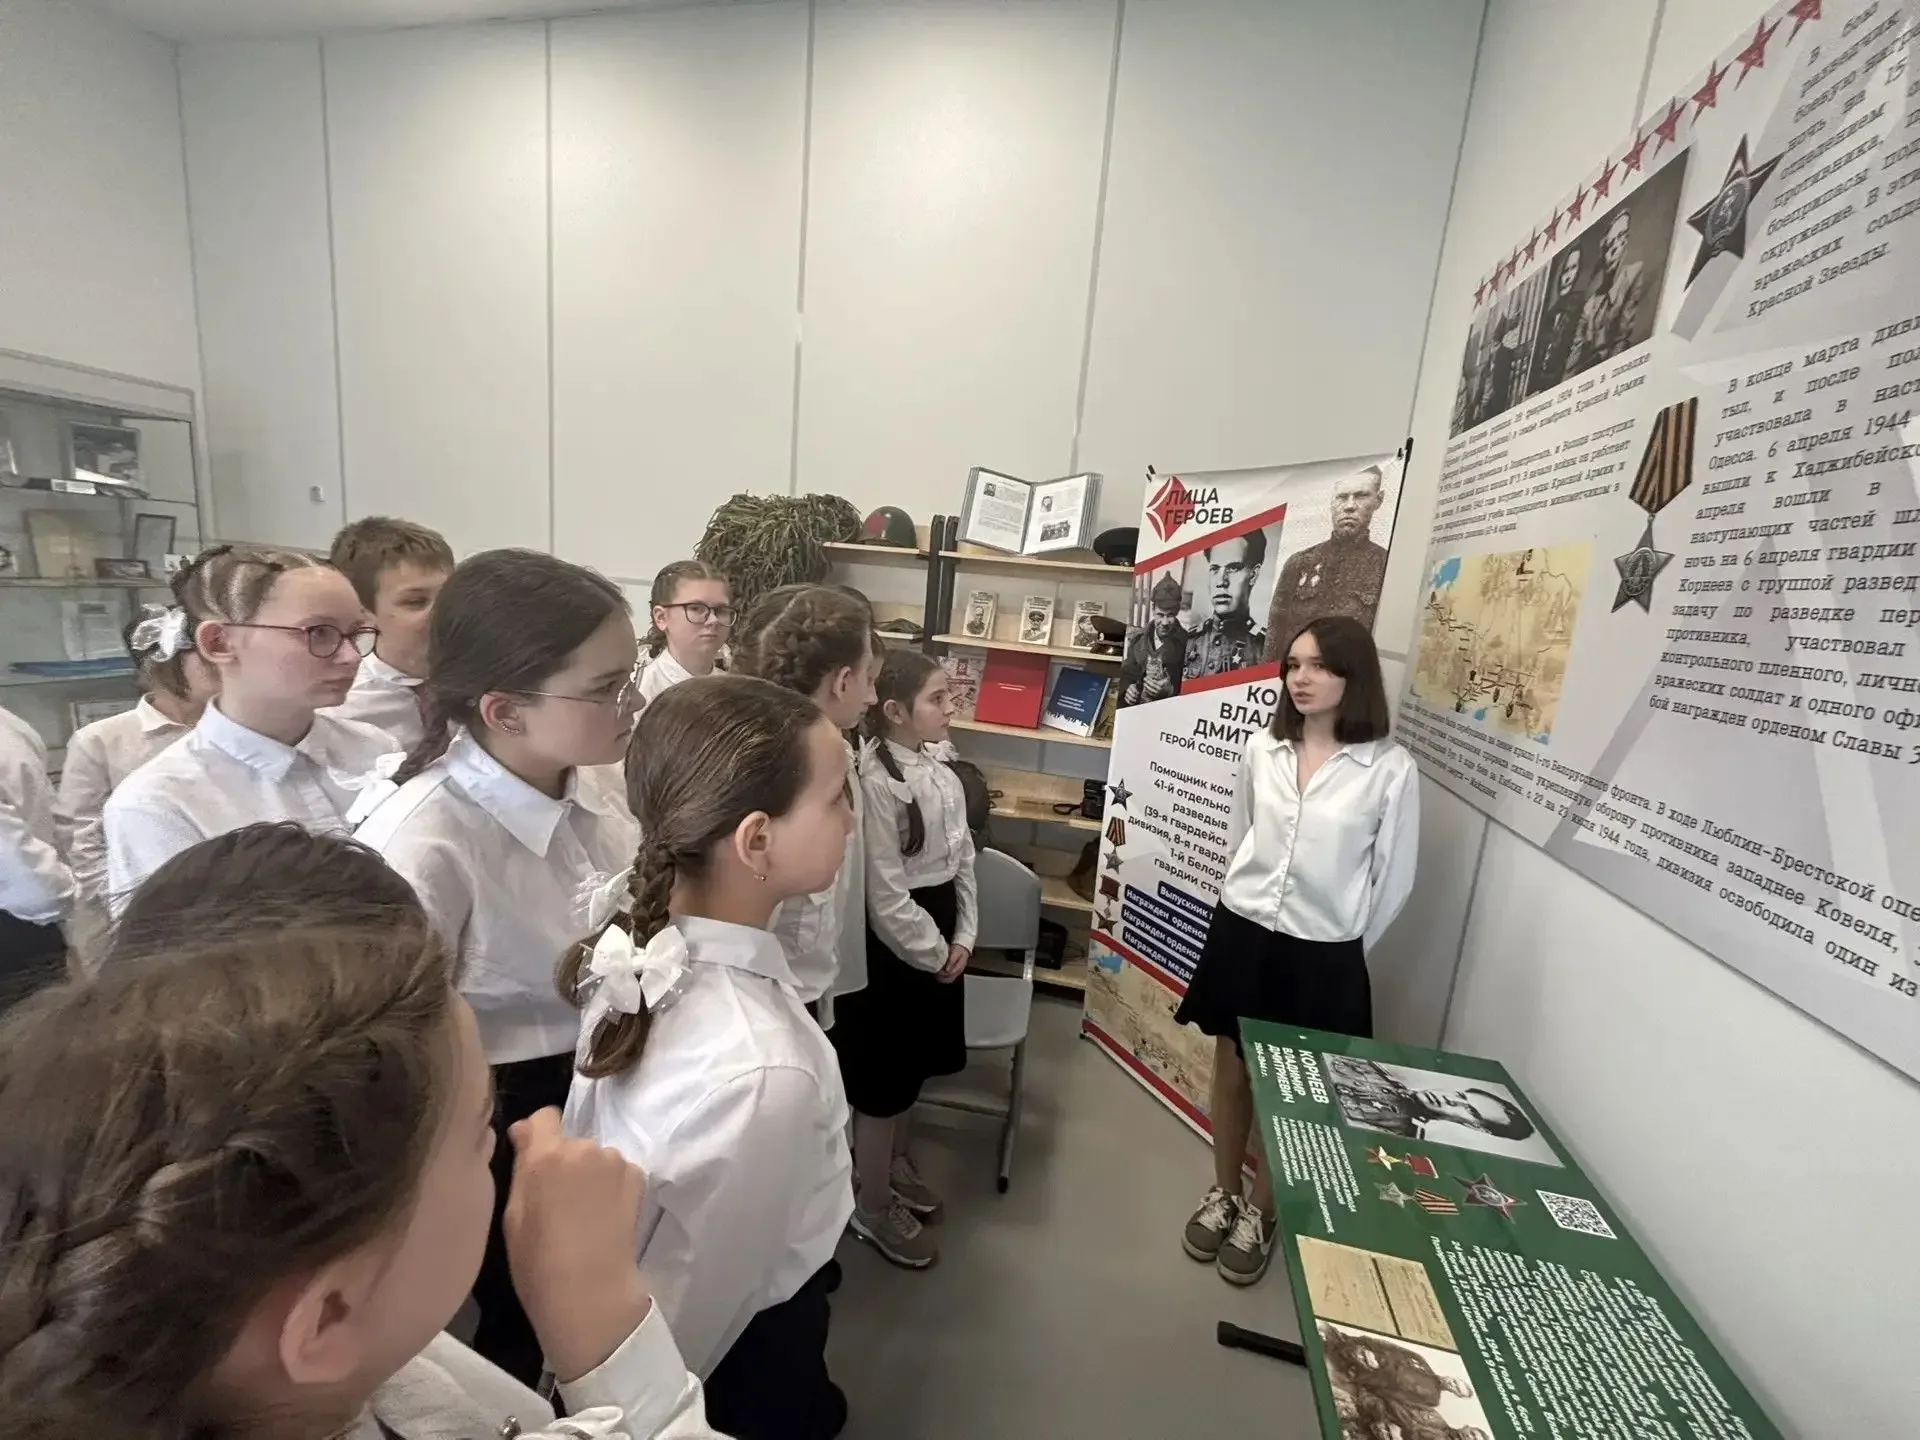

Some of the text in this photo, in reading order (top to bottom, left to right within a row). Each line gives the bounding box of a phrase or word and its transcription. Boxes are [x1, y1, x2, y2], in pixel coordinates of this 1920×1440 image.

[1747, 275, 1815, 318] Красной
[1728, 378, 1737, 393] В
[1746, 361, 1793, 387] конце
[1803, 337, 1859, 367] марта
[1773, 390, 1785, 402] и
[1805, 366, 1860, 393] после
[1714, 399, 1847, 447] участвовала в
[1768, 441, 1778, 457] 6
[1787, 426, 1853, 452] апреля
[1864, 410, 1911, 436] 1944
[1702, 443, 1920, 495] вышли к Хаджибейско
[1165, 487, 1218, 506] ЛИЦА
[1695, 482, 1881, 520] апреля вошли в
[1163, 508, 1234, 525] ГЕРОЕВ
[1690, 522, 1794, 544] наступающих
[1809, 510, 1876, 532] частей
[1684, 542, 1917, 568] ночь на 6 апреля гвардии
[1678, 574, 1918, 594] Корнеев с группой развед
[1672, 605, 1855, 622] задачу по разведке
[1666, 628, 1906, 657] противника, участвовал
[1660, 651, 1920, 693] контрольного пленного, личн
[1654, 673, 1725, 695] вражеских
[1730, 685, 1785, 705] солдат
[1789, 694, 1803, 708] и
[1808, 698, 1875, 720] одного
[1649, 695, 1670, 709] бой
[1672, 702, 1747, 727] награжден
[1752, 718, 1826, 743] орденом
[1833, 730, 1903, 760] Славы
[1160, 732, 1242, 762] ГЕРОЙ СОВЕТ
[1150, 762, 1208, 789] Помощник
[1144, 805, 1167, 823] (39-я
[1154, 779, 1174, 794] 41-й
[1177, 789, 1231, 814] отдельно
[1128, 816, 1171, 842] дивизия,
[1174, 834, 1190, 848] 8-я
[1173, 803, 1228, 830] разведыв
[1170, 848, 1185, 863] 1-й
[1656, 802, 1666, 815] В
[1668, 808, 1698, 828] ходе
[1701, 820, 1876, 902] Люблин-Брестской
[1155, 858, 1198, 885] гвардии
[1595, 801, 1637, 829] оборону
[1641, 823, 1719, 866] противника
[1726, 861, 1806, 905] западнее
[1816, 898, 1899, 953] Ковеля,
[1126, 889, 1169, 919] Награжден
[1160, 886, 1208, 919] Выпускник
[1599, 824, 1620, 845] 1944
[1656, 856, 1714, 891] дивизия
[1719, 887, 1815, 945] освободила
[1825, 941, 1880, 977] один
[1889, 972, 1918, 998] из
[1123, 909, 1166, 940] Награжден
[1125, 932, 1193, 980] Награжден меда
[1267, 1043, 1295, 1104] ДМИТРИЕВИЧ
[1282, 1047, 1306, 1096] ВЛАДИМИР
[1299, 1048, 1330, 1104] КОРНЕЕВ
